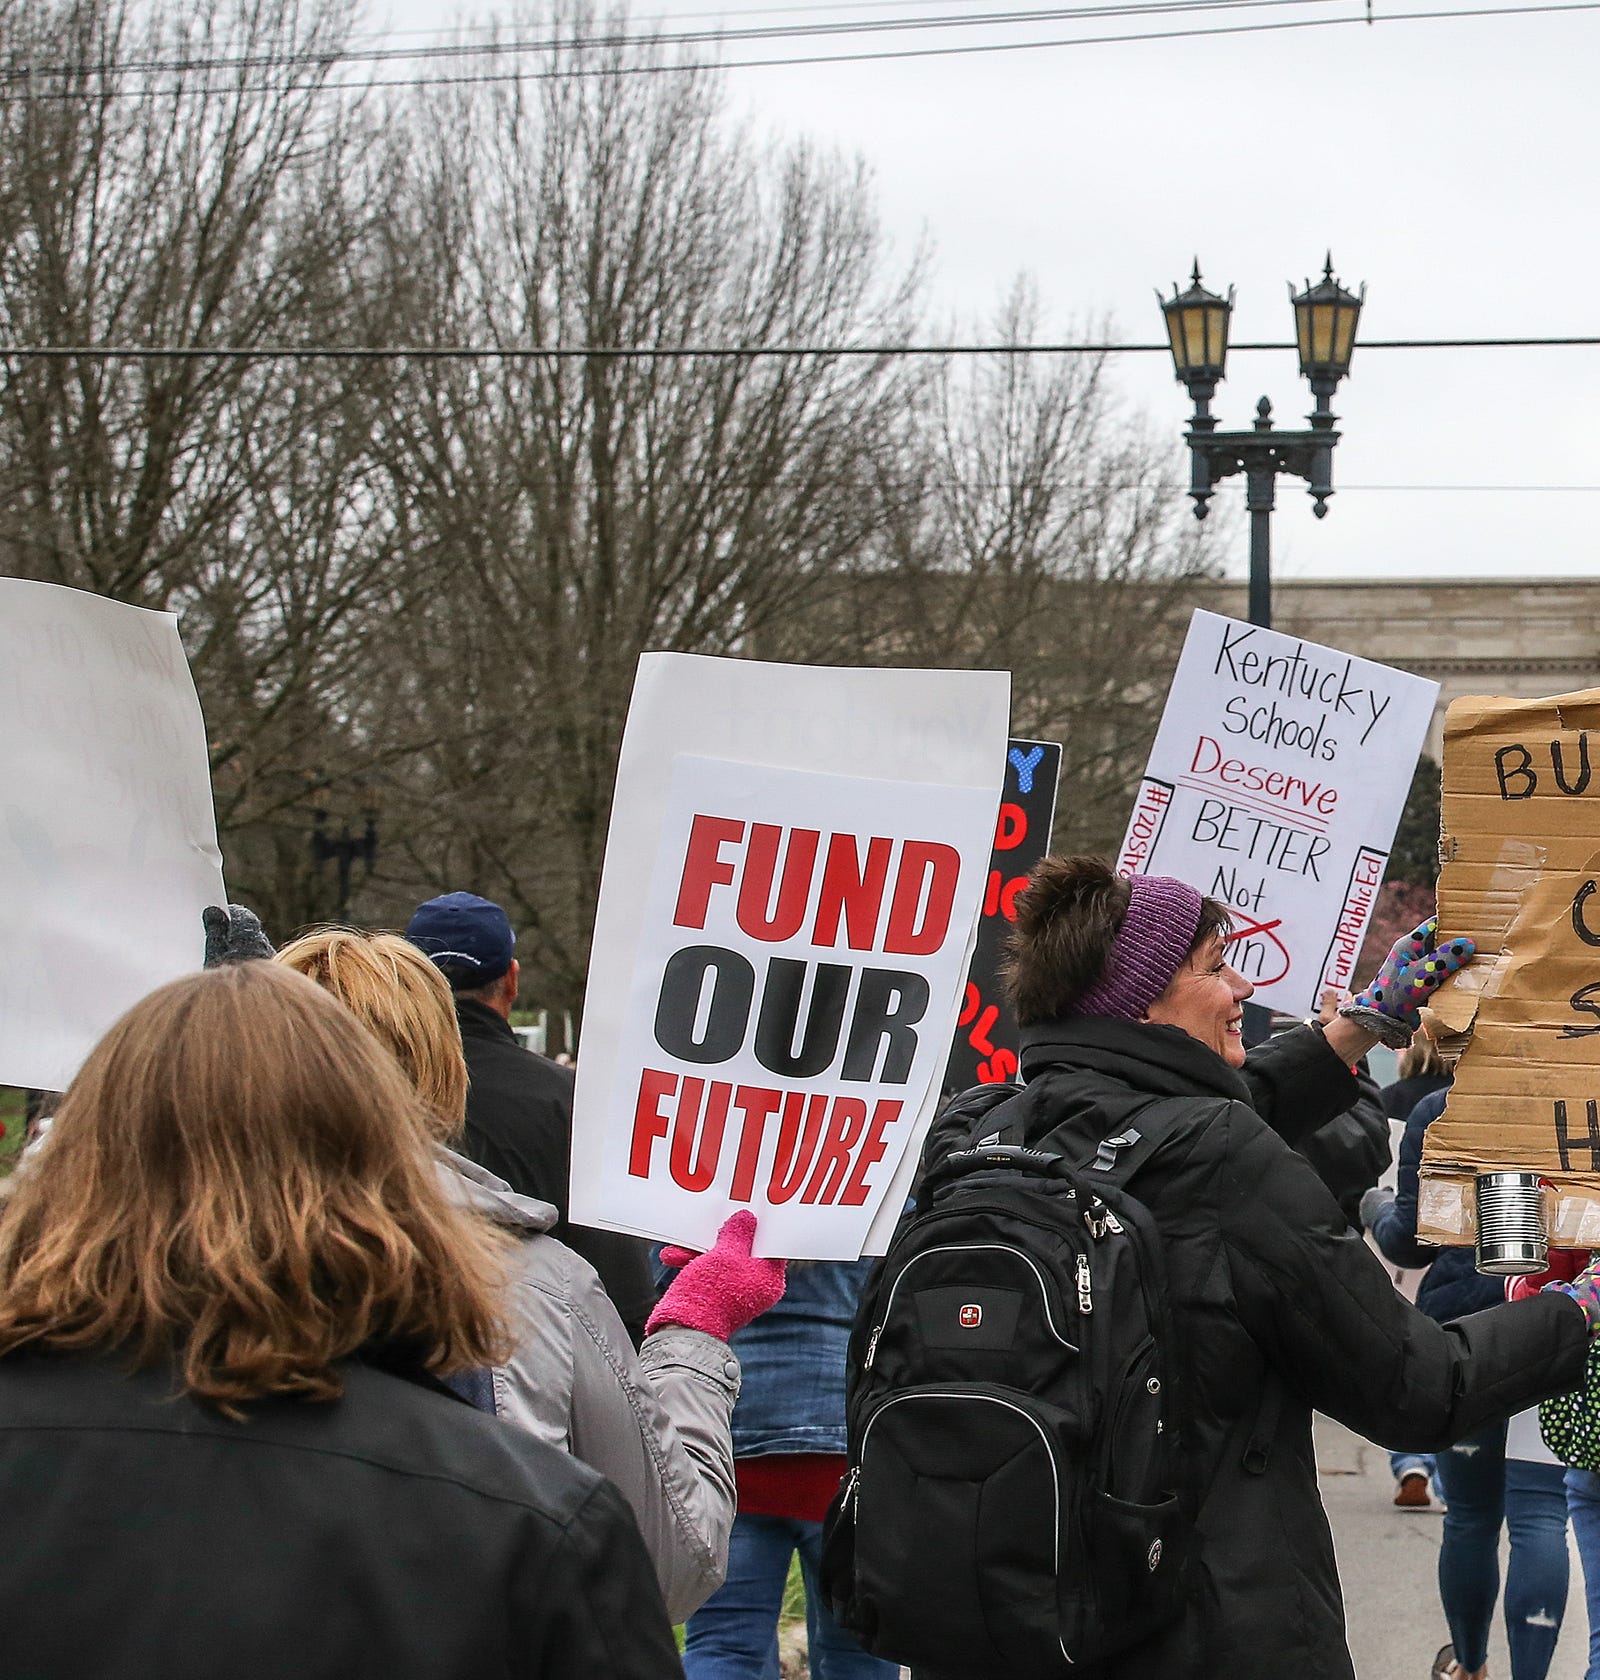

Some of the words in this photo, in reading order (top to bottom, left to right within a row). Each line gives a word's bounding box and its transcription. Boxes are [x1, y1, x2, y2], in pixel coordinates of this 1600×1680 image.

[1214, 623, 1391, 747] Kentucky
[1222, 696, 1338, 761] Schools
[1191, 736, 1339, 814] Deserve
[672, 813, 962, 956] FUND
[1191, 799, 1332, 882] BETTER
[1211, 866, 1267, 913] Not
[653, 944, 931, 1085] OUR
[628, 1067, 905, 1207] FUTURE
